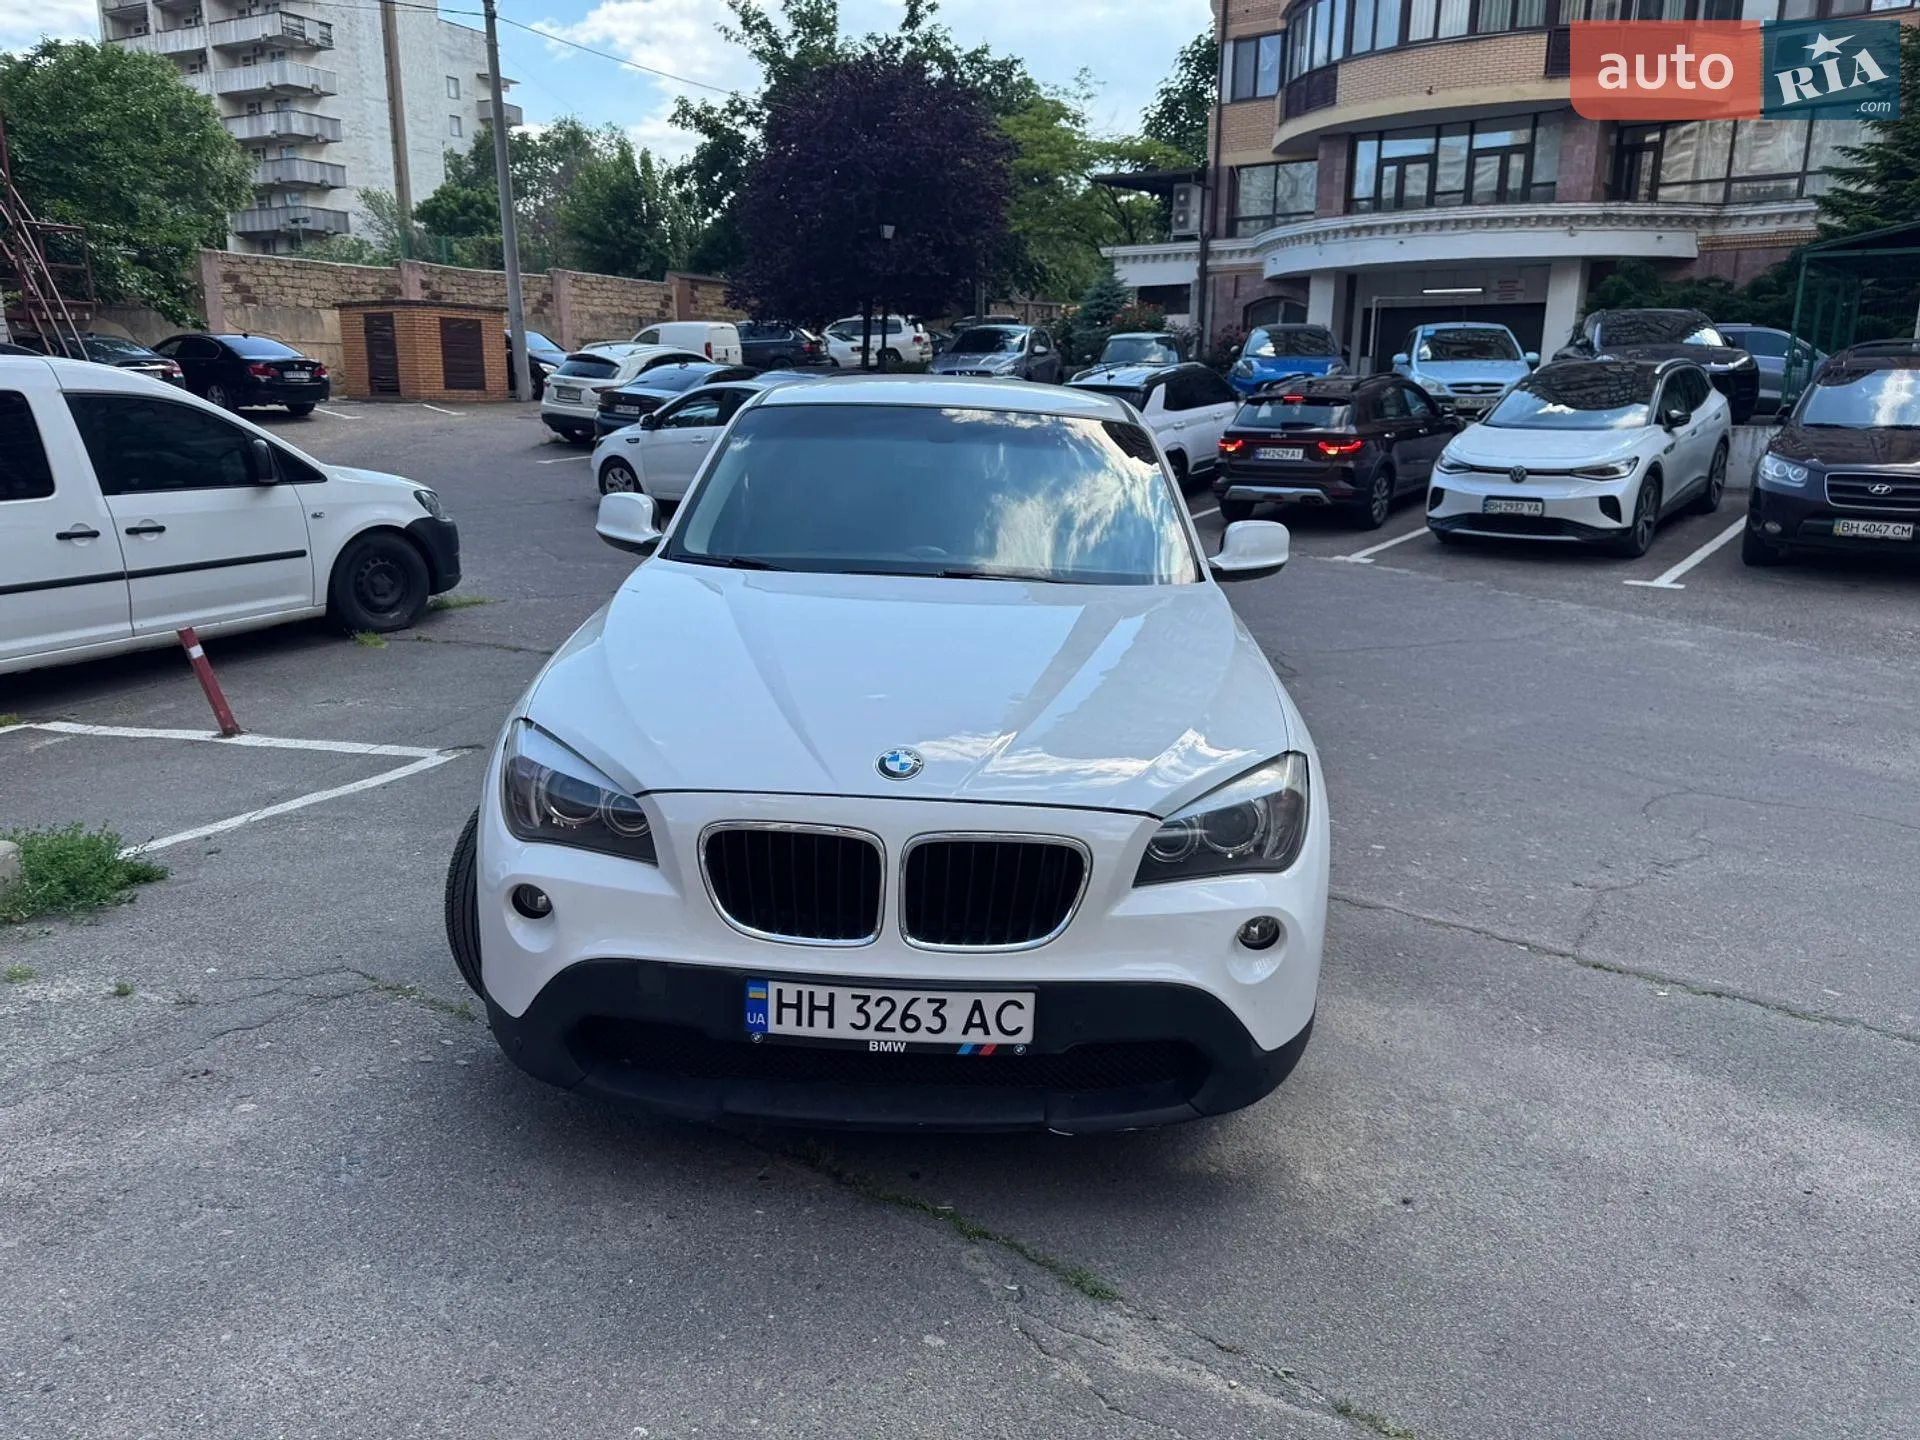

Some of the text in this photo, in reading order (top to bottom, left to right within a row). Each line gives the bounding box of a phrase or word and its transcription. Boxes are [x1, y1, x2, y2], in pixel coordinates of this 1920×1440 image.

[1488, 502, 1502, 512] BH
[1503, 502, 1525, 512] 2937
[1841, 521, 1911, 536] BH 4047 CM
[747, 1012, 766, 1025] UA
[776, 988, 1025, 1037] HH 3263 AC
[869, 1041, 906, 1053] BMW
